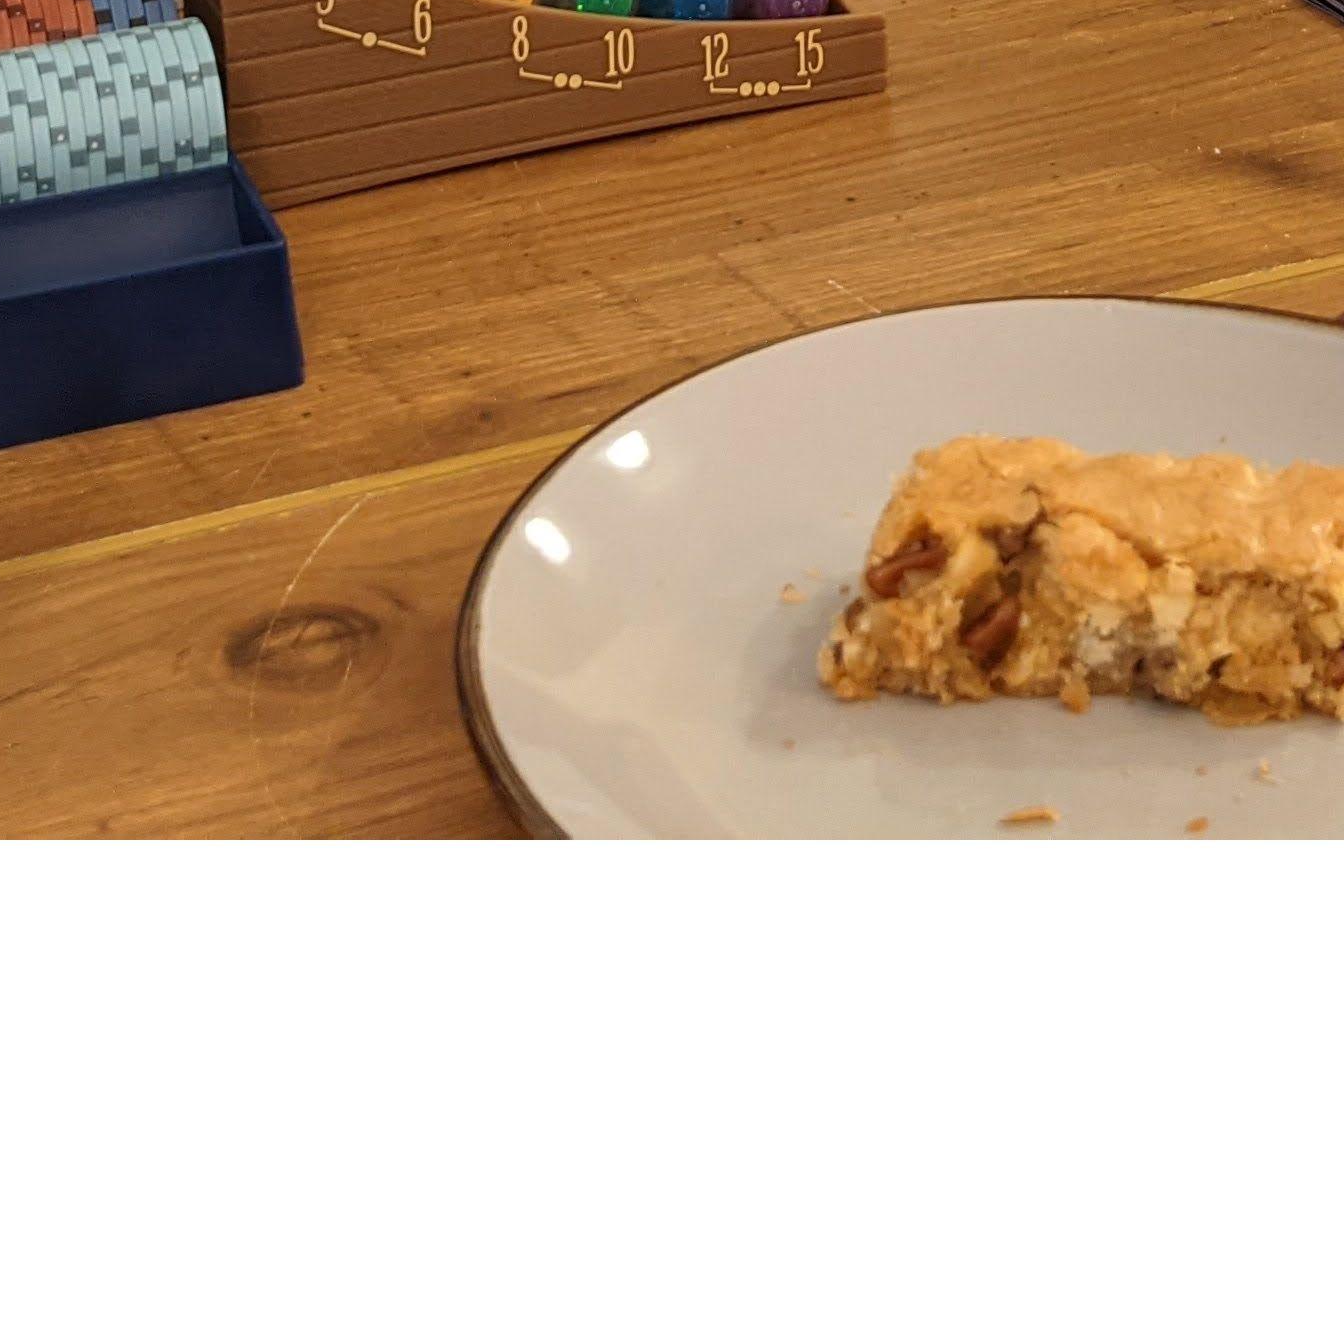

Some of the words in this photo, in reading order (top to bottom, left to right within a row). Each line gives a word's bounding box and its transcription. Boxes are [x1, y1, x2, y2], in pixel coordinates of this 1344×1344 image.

[511, 14, 531, 63] 8
[602, 27, 637, 77] 10
[700, 31, 731, 82] 12
[794, 27, 825, 77] 15
